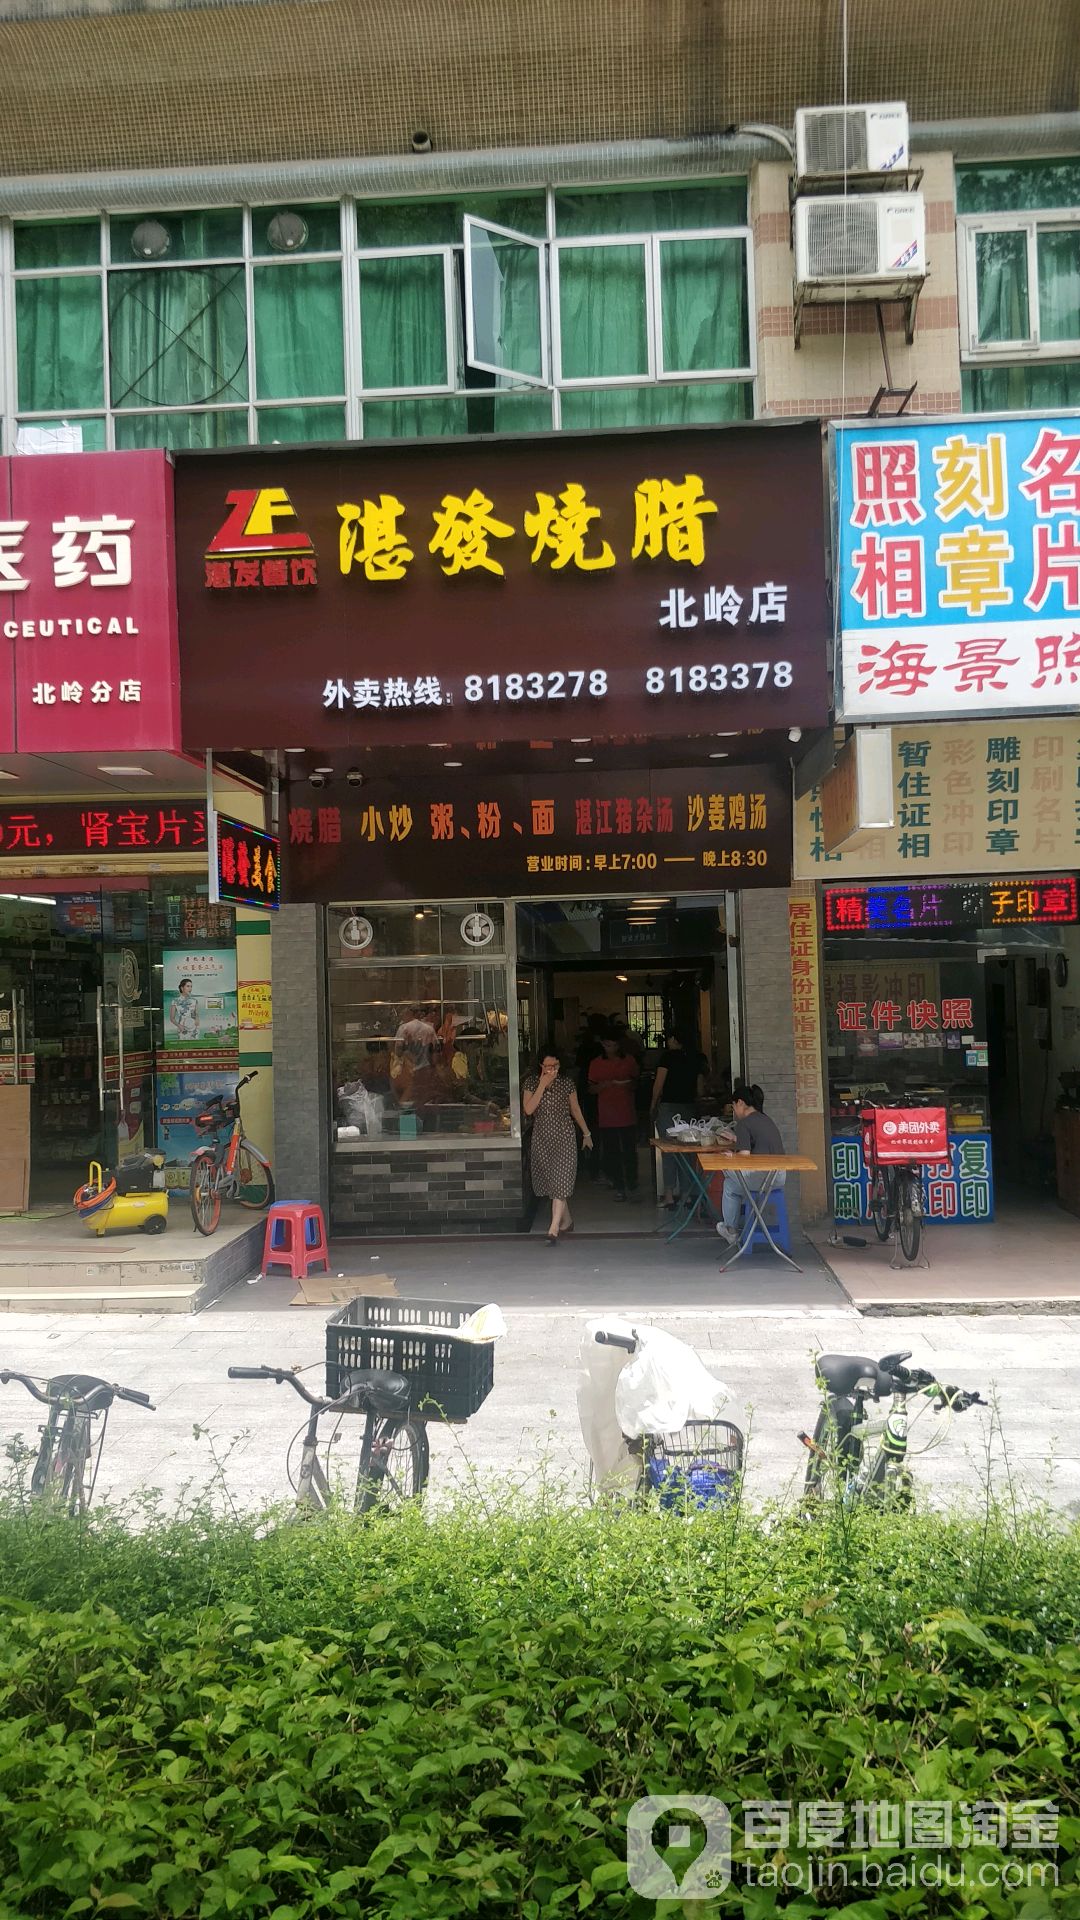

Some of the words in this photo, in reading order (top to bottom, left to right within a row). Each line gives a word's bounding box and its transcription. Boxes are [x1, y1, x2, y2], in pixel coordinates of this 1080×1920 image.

[852, 443, 924, 618] 照相
[934, 435, 1010, 614] 刻章
[204, 558, 318, 588] 湛发餐饮
[4, 617, 139, 638] CEUTICAL
[659, 582, 787, 629] 北岭店
[32, 679, 142, 705] 北岭分店
[464, 669, 608, 702] 8183278
[646, 661, 793, 695] 8183378
[288, 806, 341, 844] 烧腊
[361, 804, 413, 842] 小炒
[575, 796, 673, 836] 湛江猪杂汤
[687, 793, 767, 832] 沙姜鸡汤
[897, 740, 932, 859] 暂住证相
[942, 739, 975, 856] 彩色冲印
[986, 736, 1021, 855] 雕刻印章
[1031, 736, 1063, 853] 印刷名片
[836, 998, 973, 1031] 证件快照
[898, 1121, 940, 1134] 美团外卖
[832, 1142, 861, 1219] 印刷
[960, 1140, 989, 1218] 复印
